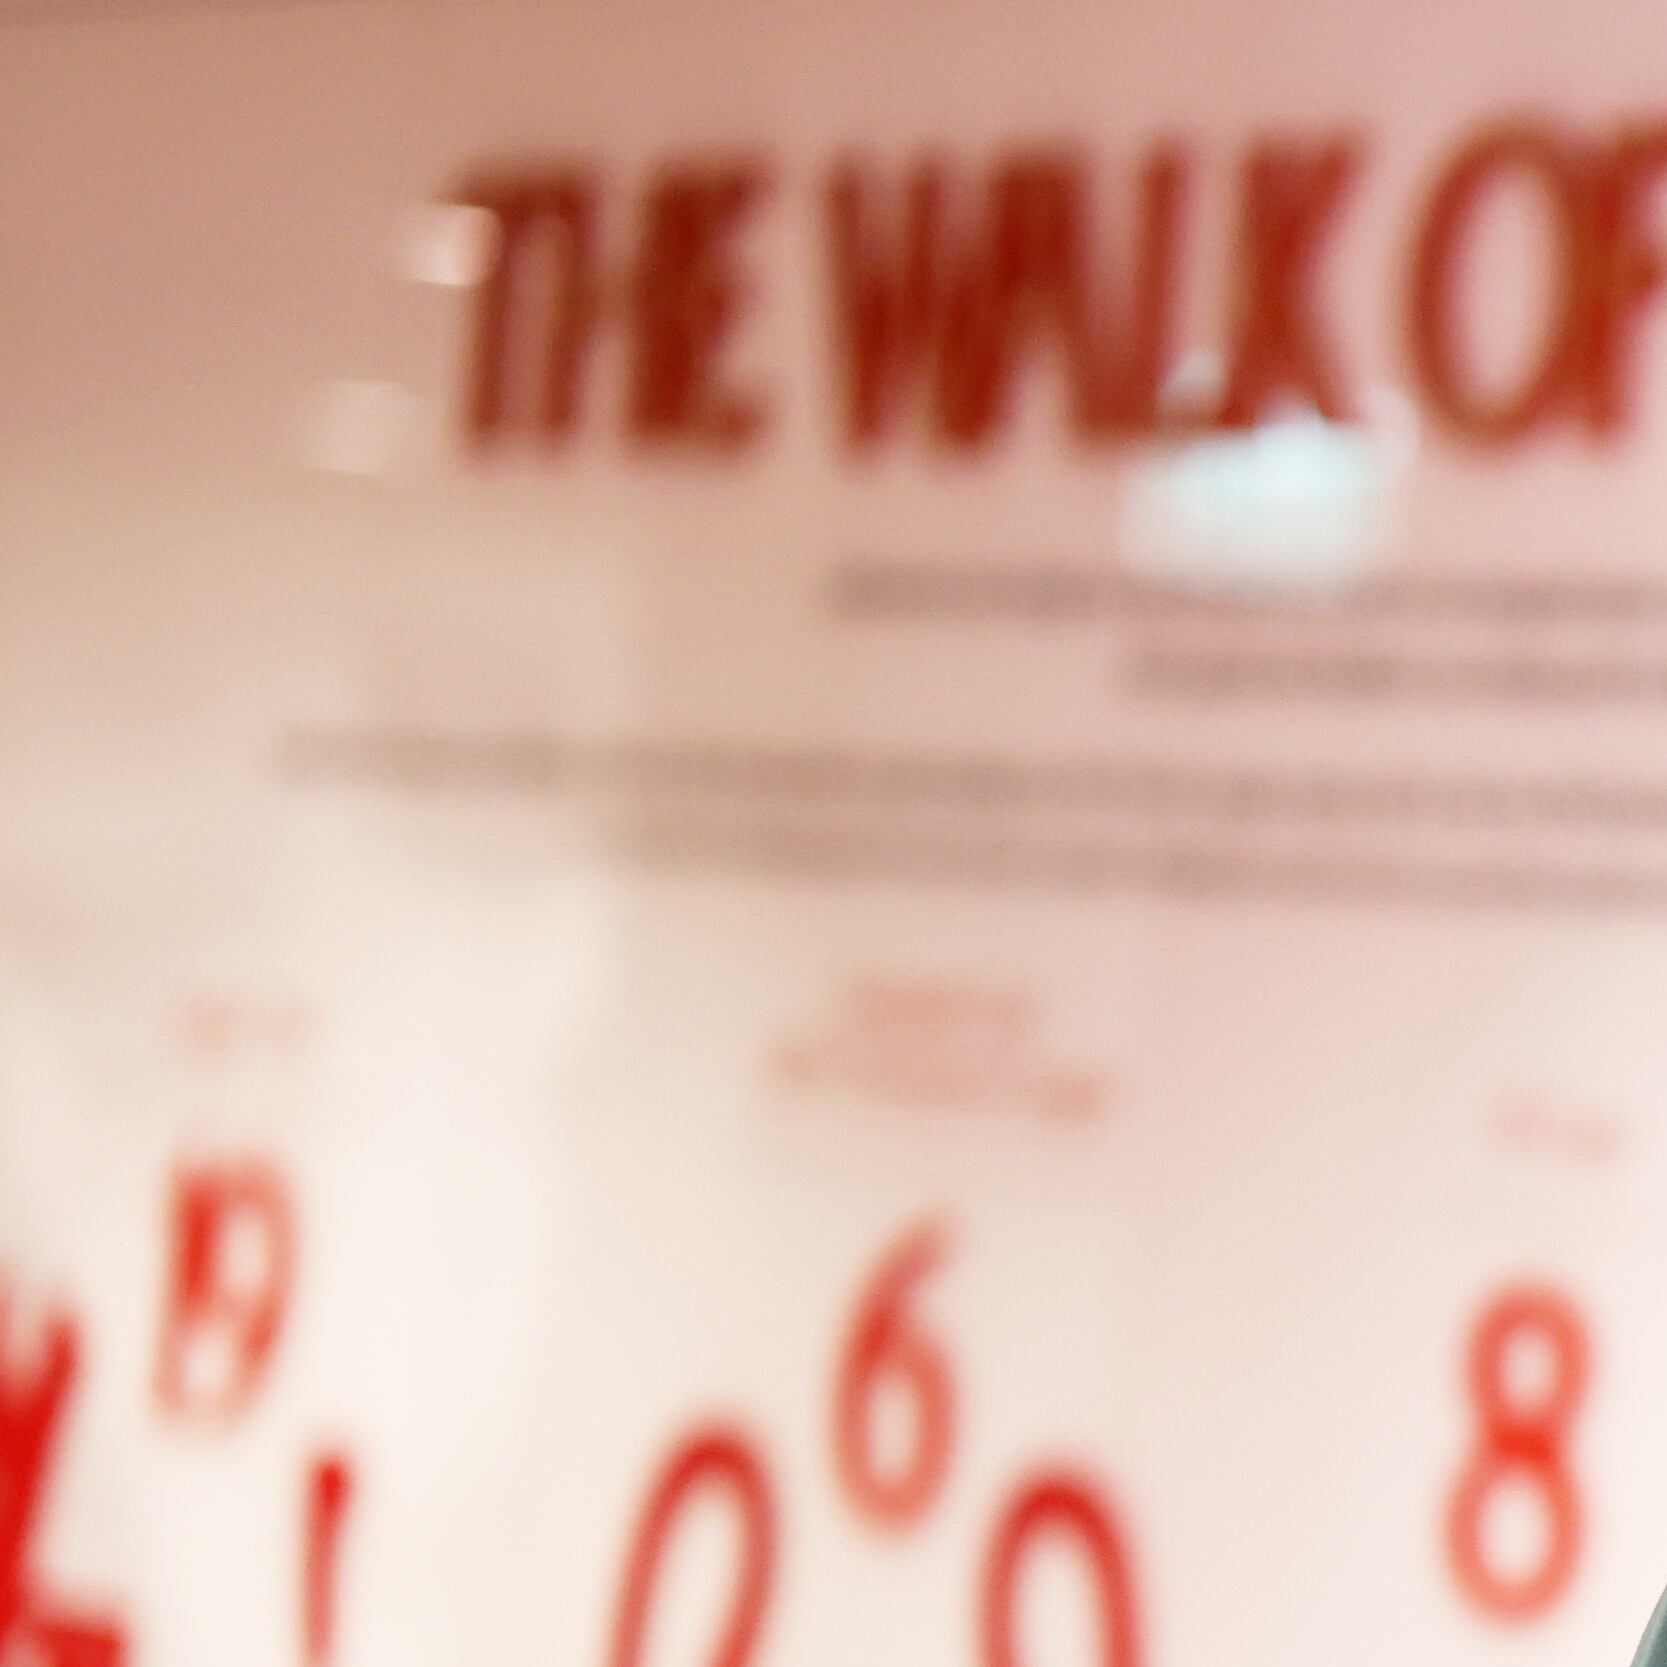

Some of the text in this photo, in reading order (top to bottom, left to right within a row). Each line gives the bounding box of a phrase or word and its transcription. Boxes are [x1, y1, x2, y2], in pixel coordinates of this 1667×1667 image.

[458, 155, 775, 455] THE
[832, 1216, 956, 1534] 6
[1445, 1280, 1596, 1624] 8
